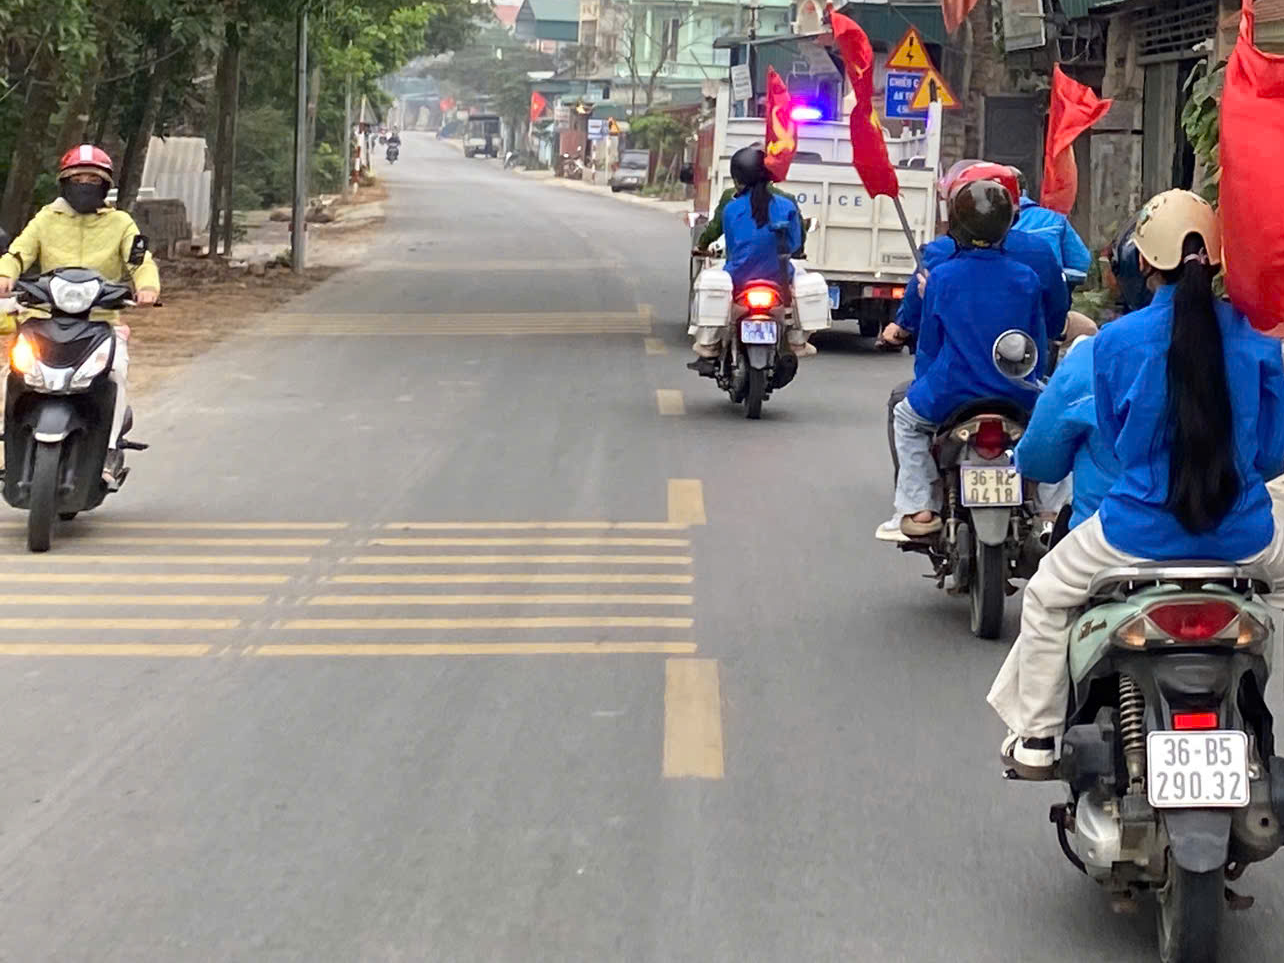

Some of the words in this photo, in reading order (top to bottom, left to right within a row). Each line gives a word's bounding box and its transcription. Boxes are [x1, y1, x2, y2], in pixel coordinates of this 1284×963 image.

[796, 192, 863, 207] OLICE
[971, 487, 1013, 503] 0418
[1164, 737, 1232, 766] 36-B5
[1156, 771, 1241, 800] 290.32
